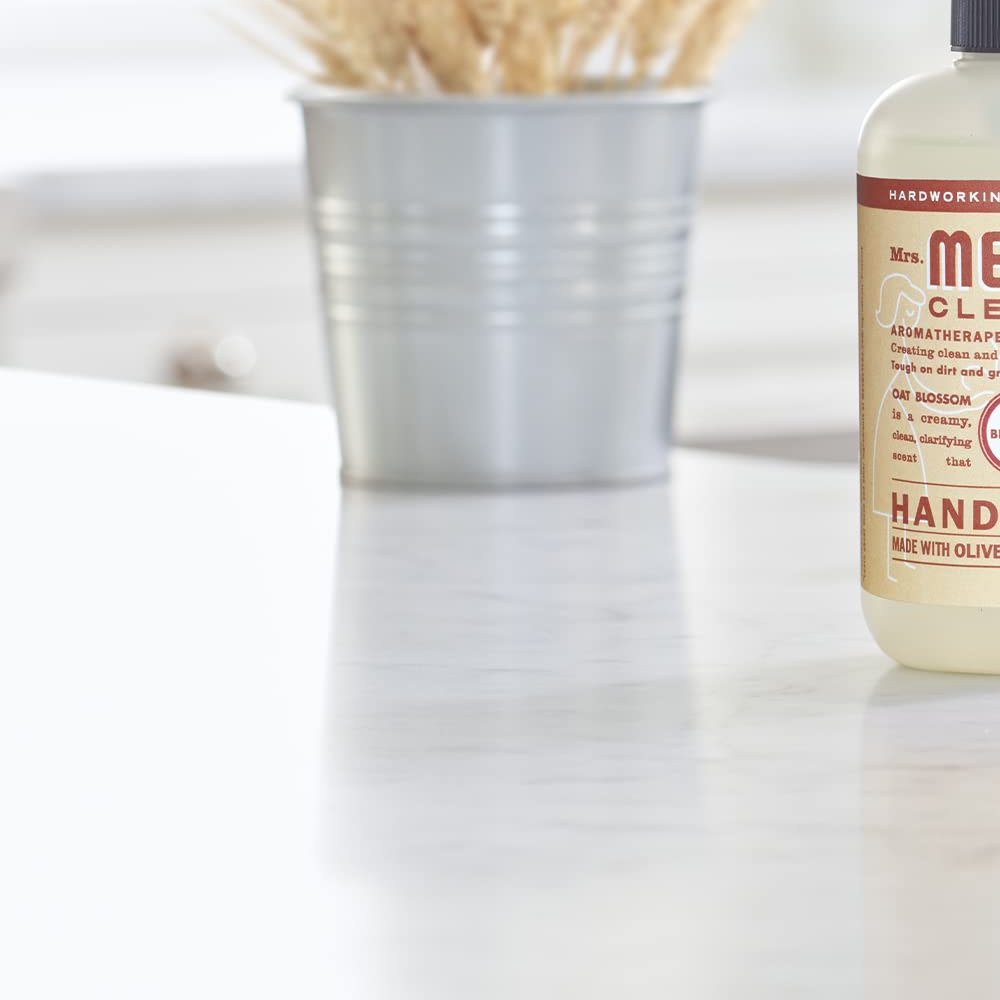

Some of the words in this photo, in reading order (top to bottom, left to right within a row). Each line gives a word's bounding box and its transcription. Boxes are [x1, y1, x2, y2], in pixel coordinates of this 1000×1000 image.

[889, 246, 924, 265] Mrs.
[890, 342, 935, 360] Creating
[937, 348, 970, 359] clean
[973, 350, 999, 361] and
[891, 360, 916, 374] Tough
[919, 366, 933, 374] on
[936, 365, 957, 376] dirt
[960, 366, 984, 377] and
[892, 388, 910, 401] OAT
[915, 391, 972, 406] BLOSSOM
[892, 408, 901, 420] is
[907, 413, 914, 422] a
[920, 414, 972, 429] creamy,
[892, 430, 917, 444] clean,
[919, 433, 972, 449] clarifying
[892, 452, 917, 463] scent
[945, 456, 972, 468] that
[891, 491, 999, 531] HAND
[892, 535, 918, 554] MADE
[919, 540, 951, 557] WITH
